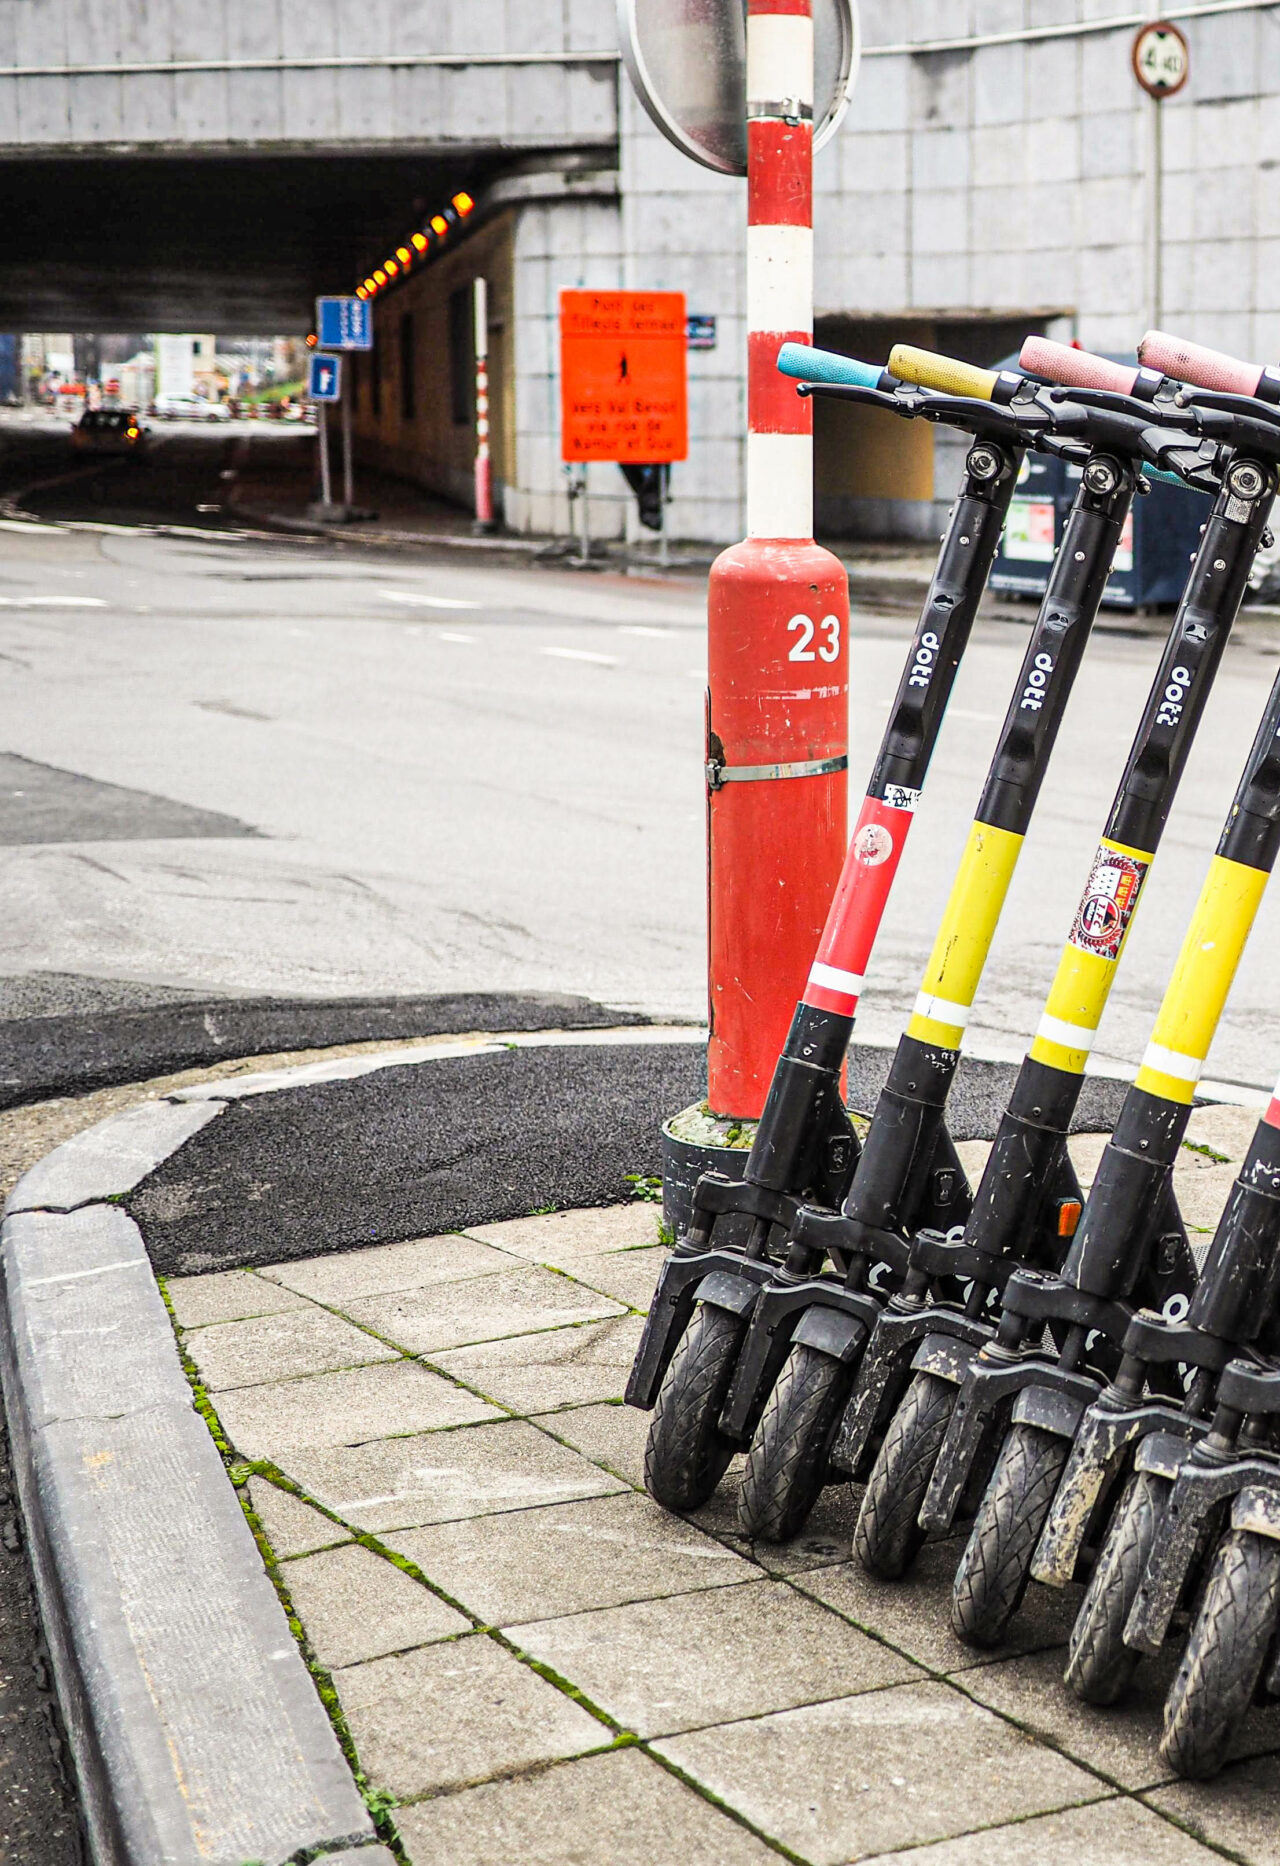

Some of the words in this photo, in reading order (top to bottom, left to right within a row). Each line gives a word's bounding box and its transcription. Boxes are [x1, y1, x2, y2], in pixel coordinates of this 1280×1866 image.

[787, 613, 840, 663] 23
[908, 632, 940, 687] dott
[1020, 652, 1054, 711] dott
[1156, 666, 1191, 727] dott
